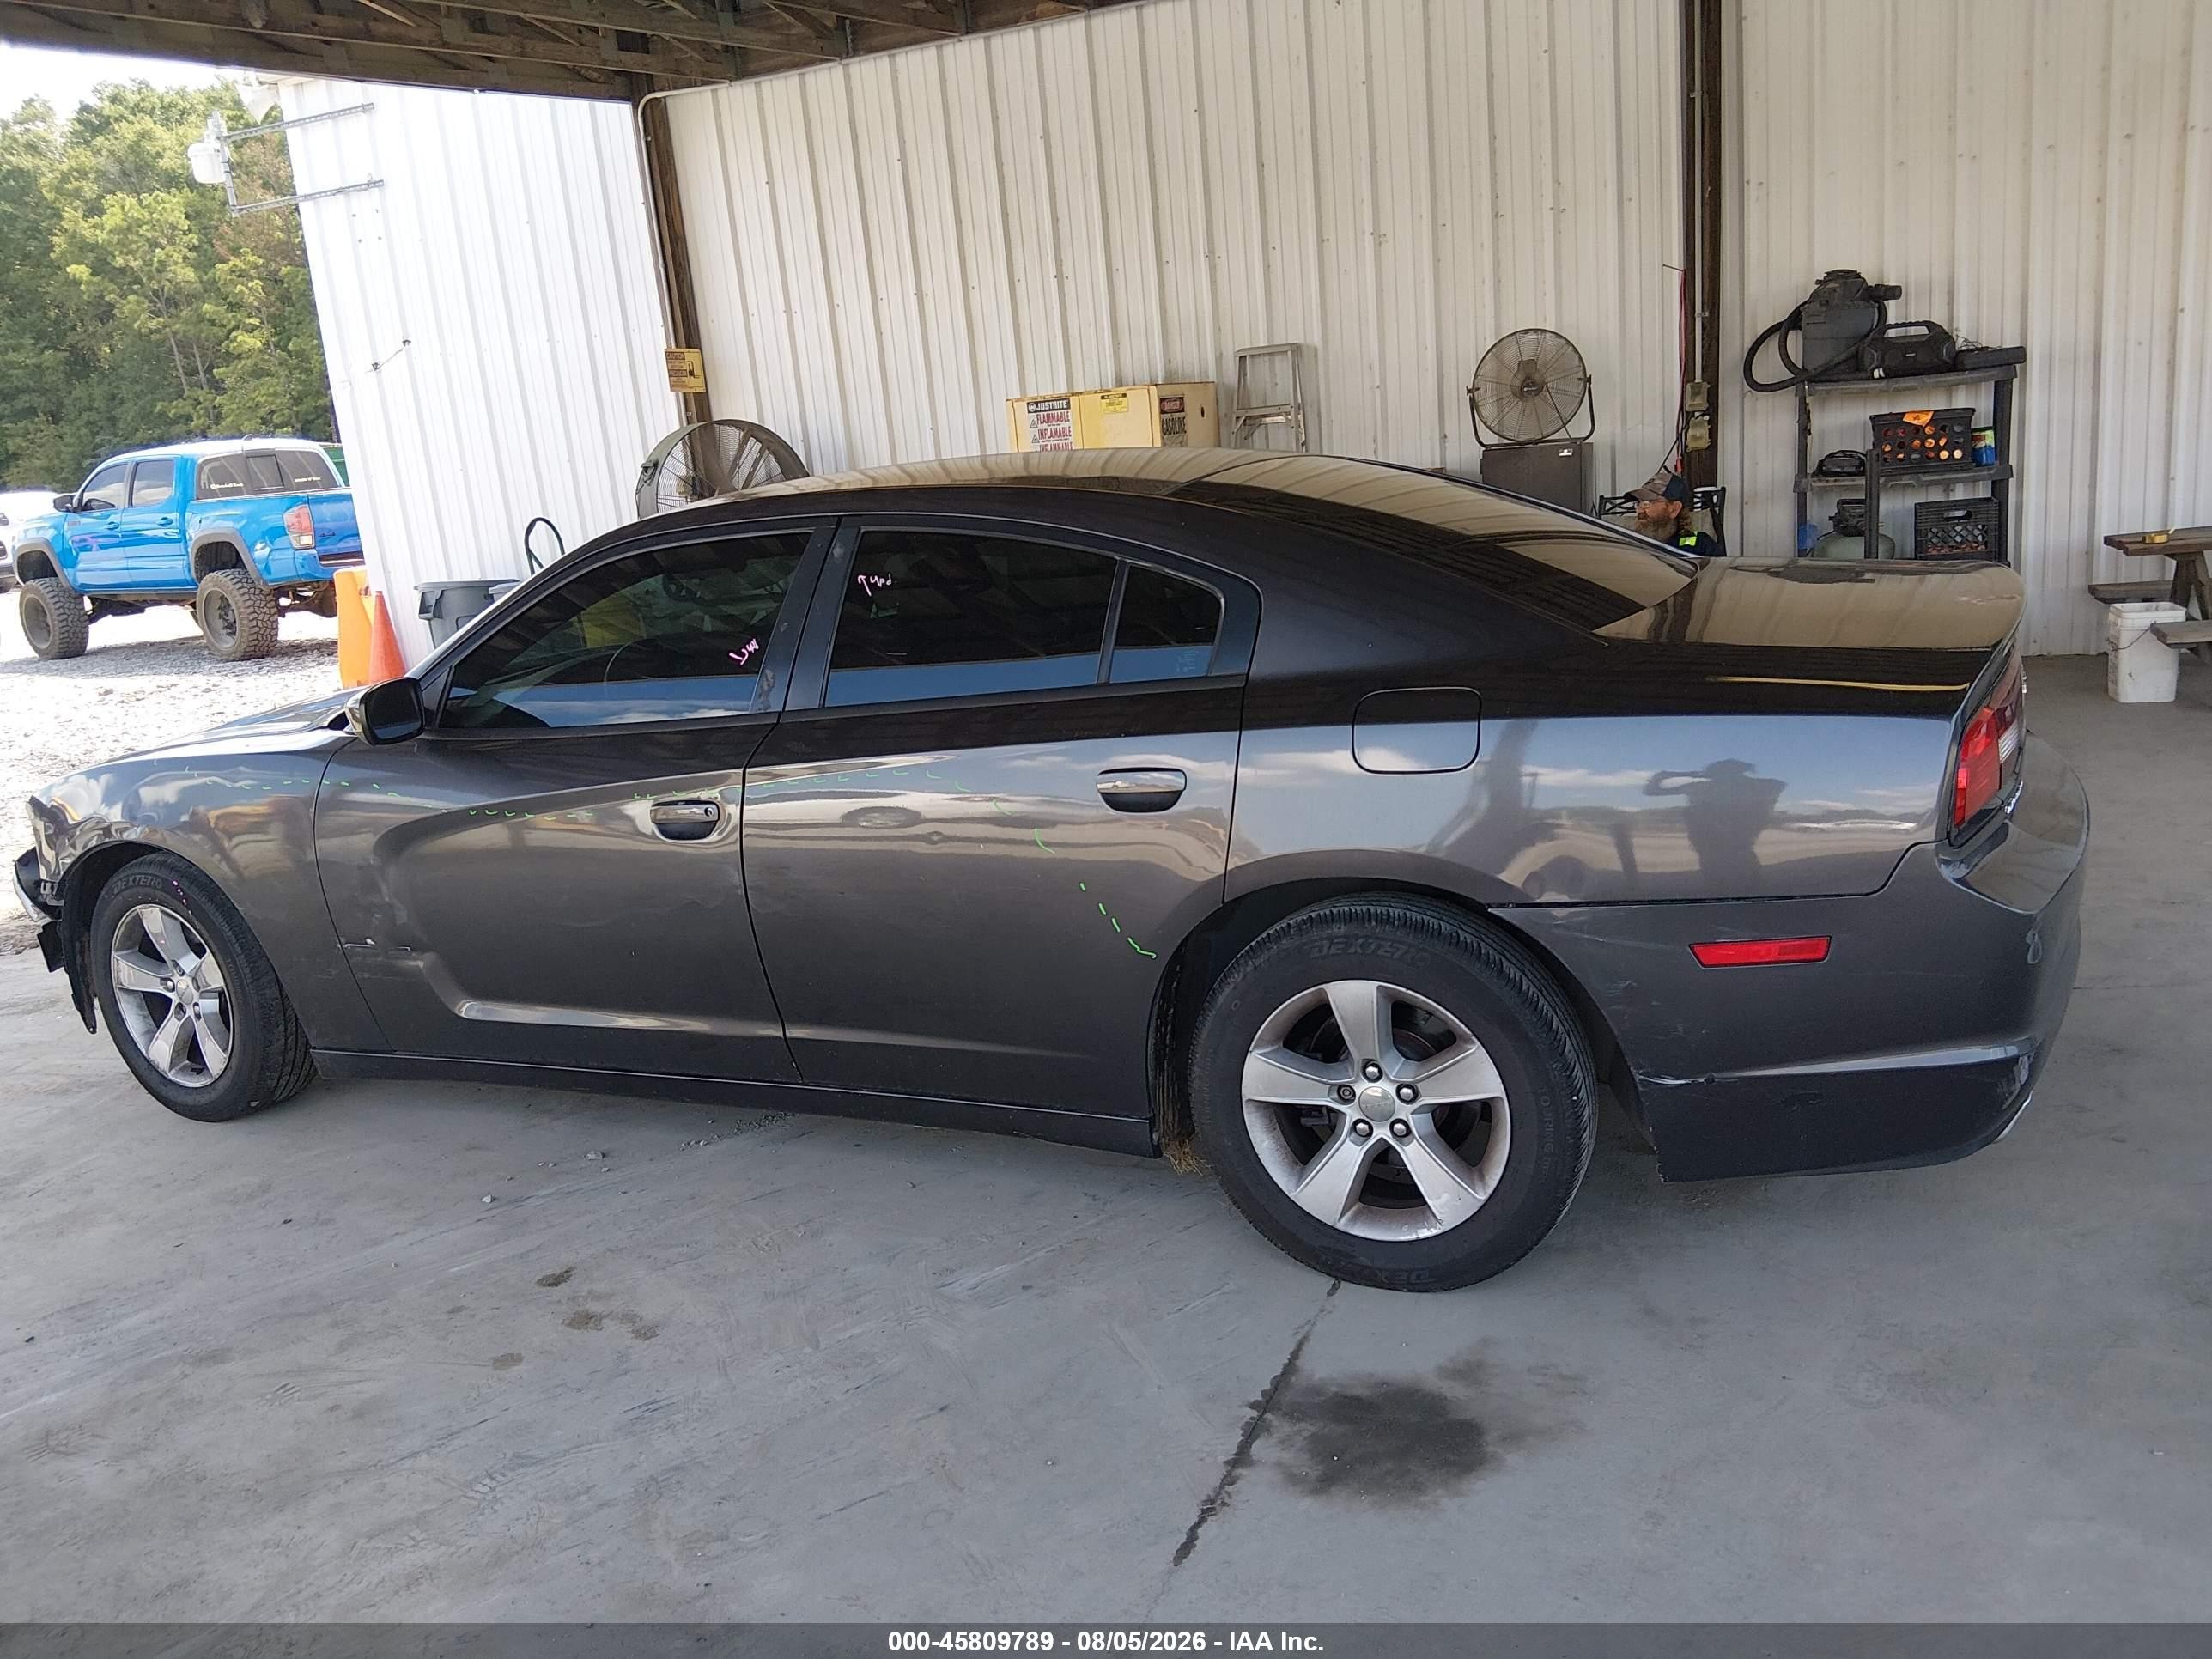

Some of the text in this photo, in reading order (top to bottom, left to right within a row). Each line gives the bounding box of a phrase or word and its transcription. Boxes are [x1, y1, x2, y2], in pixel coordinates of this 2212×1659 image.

[1036, 399, 1068, 411] JUSTRITE
[1036, 412, 1071, 425] FLAMMABLE
[1037, 426, 1073, 440] INFLAMABLE
